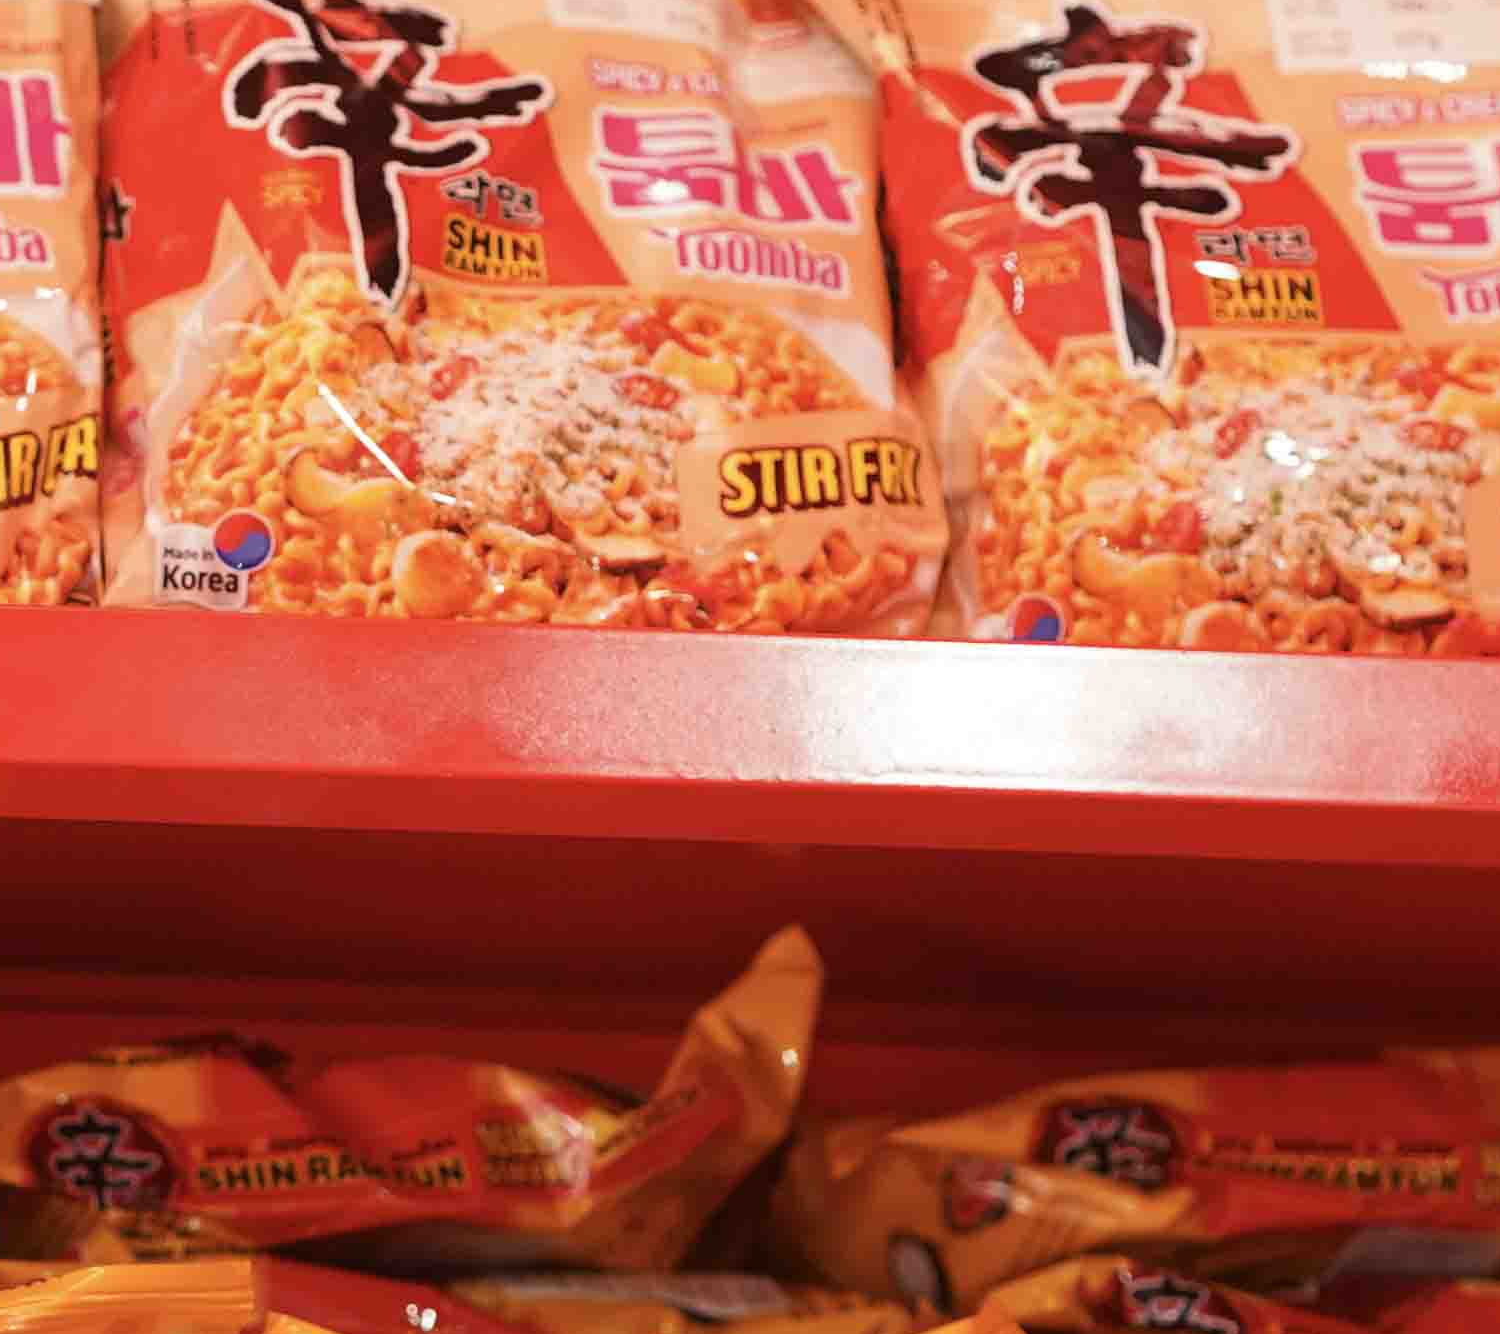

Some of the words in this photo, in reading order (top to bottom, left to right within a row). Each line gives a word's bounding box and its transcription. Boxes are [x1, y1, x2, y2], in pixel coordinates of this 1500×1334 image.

[444, 218, 542, 263] SHIN
[1209, 273, 1318, 304] SHIN
[718, 445, 843, 518] STIR
[160, 564, 241, 595] Korea
